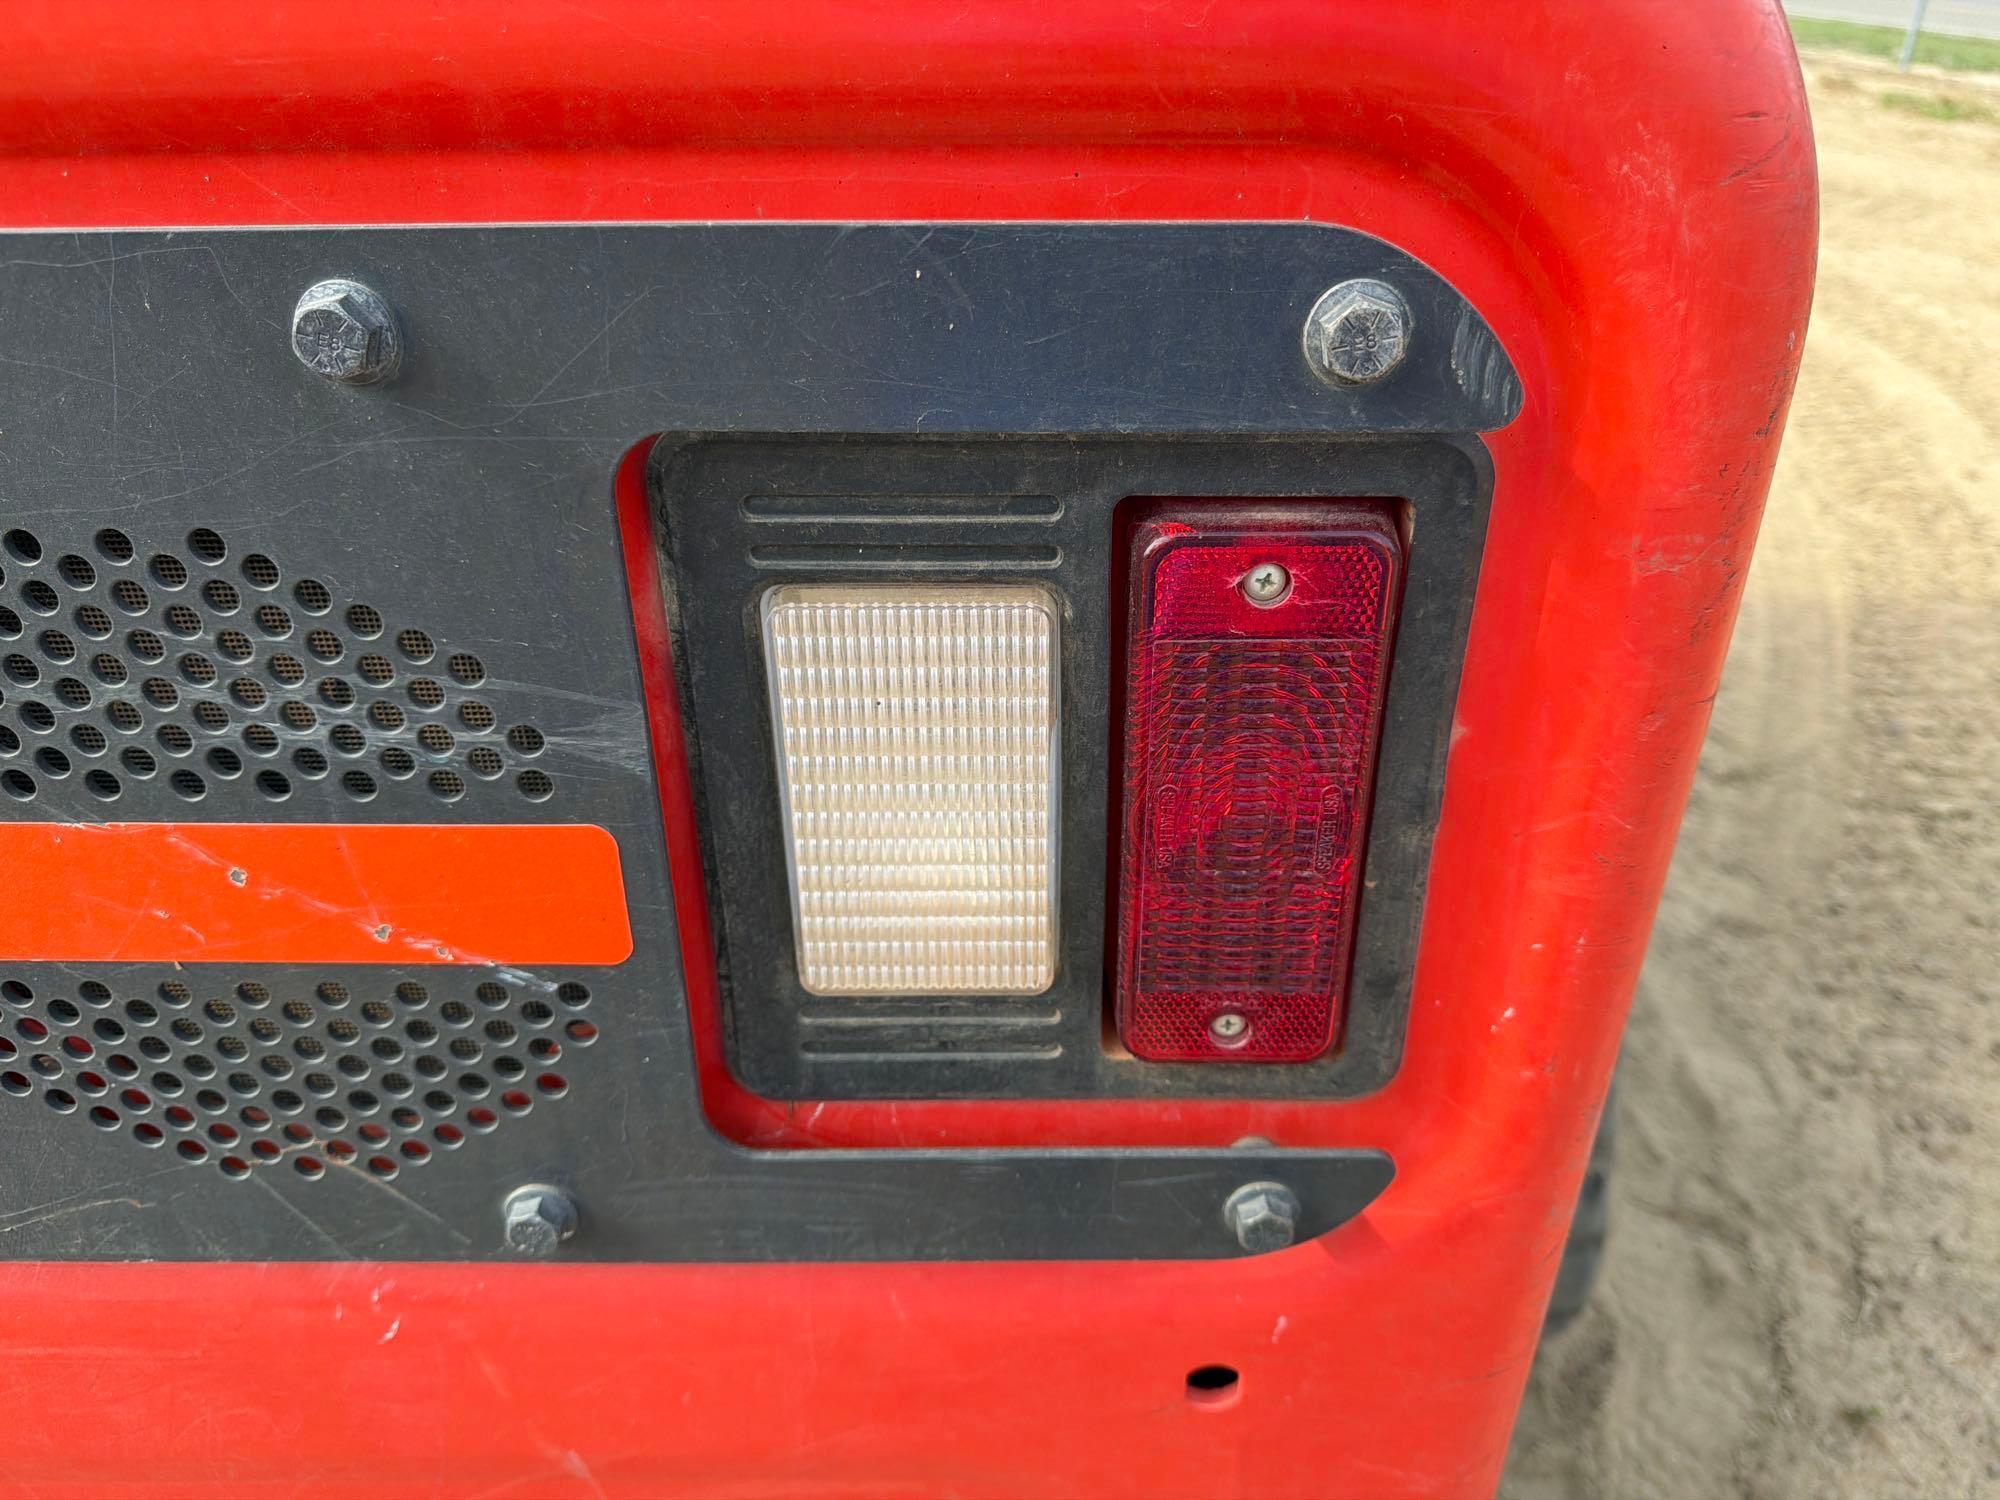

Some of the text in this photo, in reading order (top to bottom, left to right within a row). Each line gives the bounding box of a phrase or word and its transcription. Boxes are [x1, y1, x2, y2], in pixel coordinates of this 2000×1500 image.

[317, 331, 342, 352] E8
[1157, 790, 1177, 870] SPEAKER USA
[1316, 792, 1341, 871] SPEAKER USA
